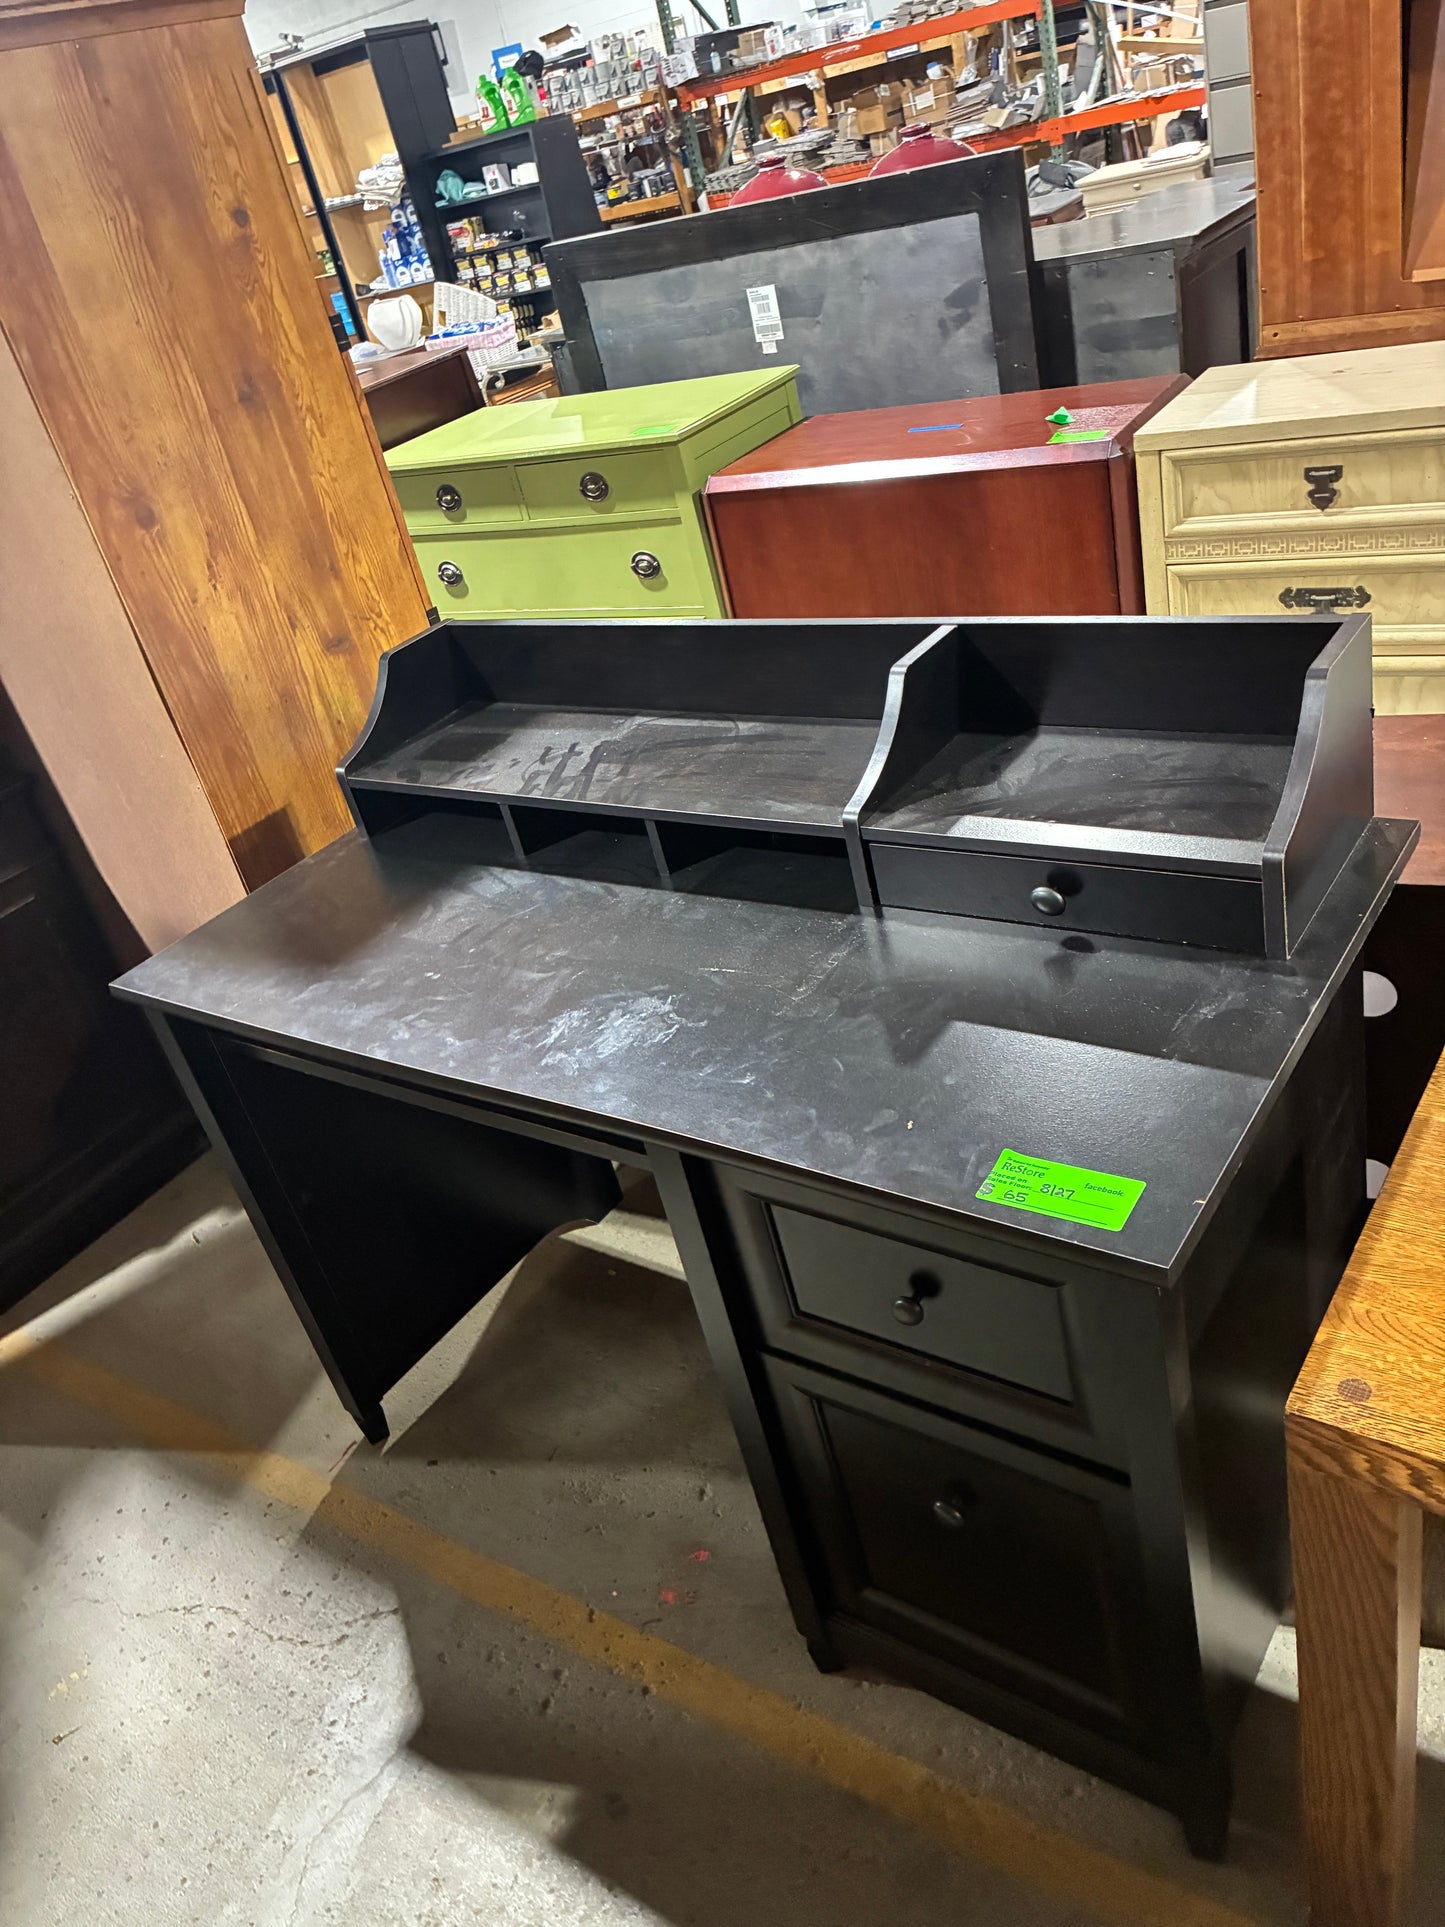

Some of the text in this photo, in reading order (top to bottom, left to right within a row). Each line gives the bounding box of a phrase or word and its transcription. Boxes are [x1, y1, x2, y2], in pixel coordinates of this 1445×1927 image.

[1001, 1161, 1046, 1178] ReStore
[979, 1182, 1029, 1202] $ 65
[1084, 1182, 1124, 1197] facebook
